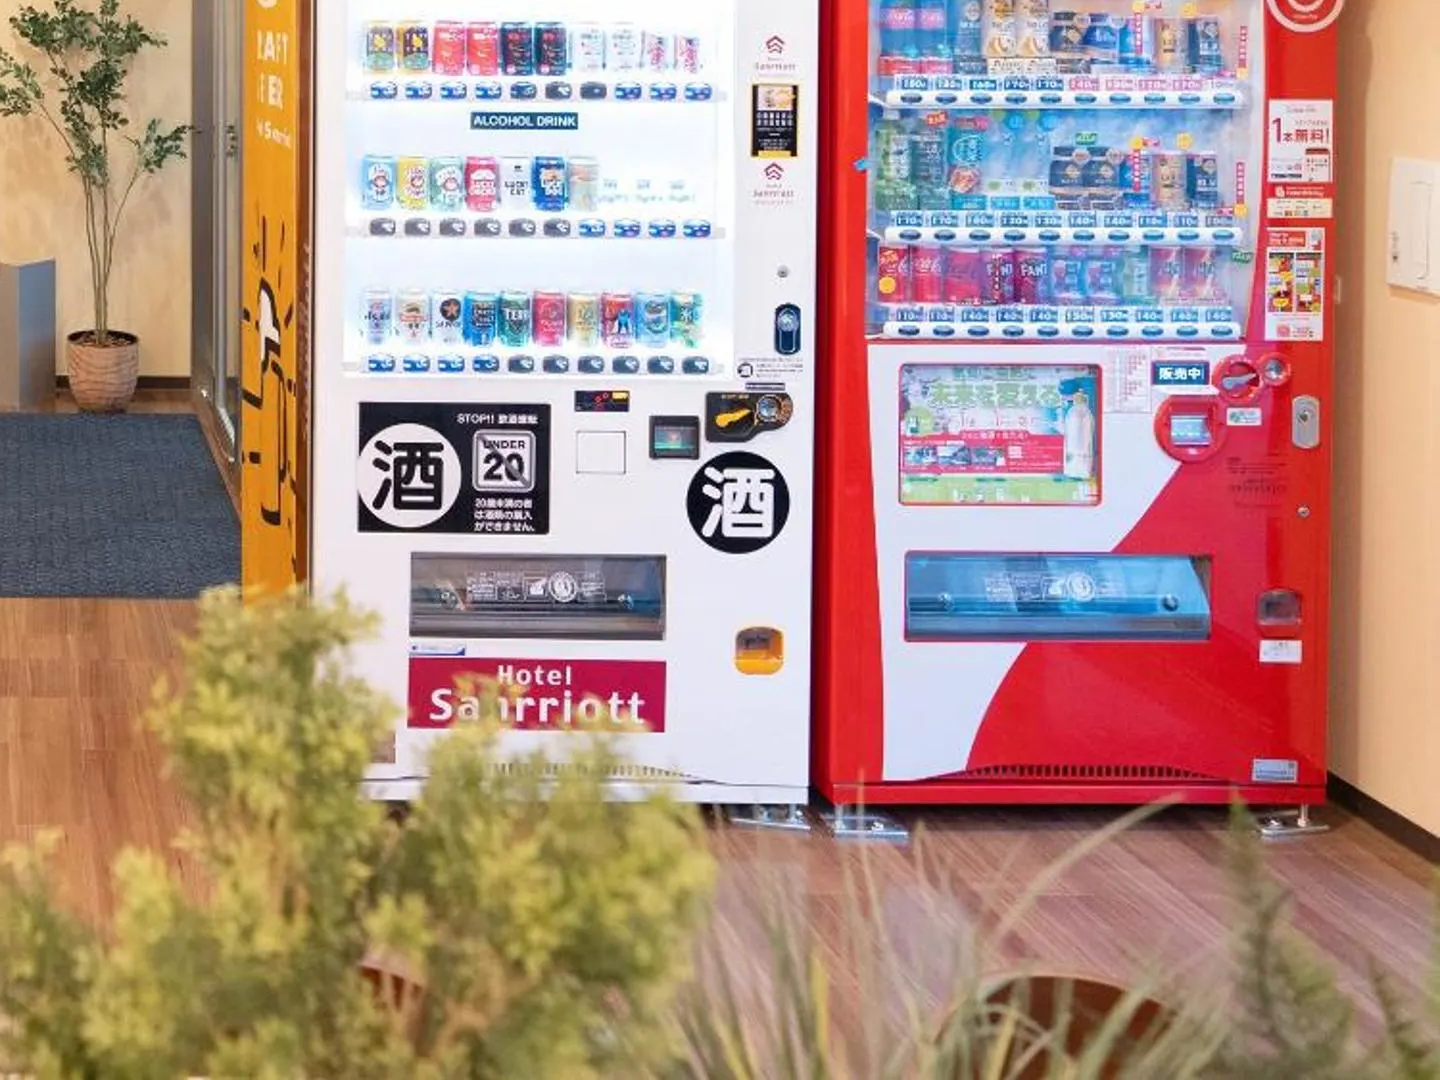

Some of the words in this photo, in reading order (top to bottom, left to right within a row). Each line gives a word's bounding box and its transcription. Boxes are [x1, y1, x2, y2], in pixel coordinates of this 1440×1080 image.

[472, 115, 534, 127] ALCOHOL
[536, 115, 577, 128] DRINK
[1159, 366, 1202, 380] 販売中
[483, 439, 527, 450] UNDER
[371, 440, 445, 511] 酒
[483, 453, 525, 482] 20
[701, 467, 776, 538] 酒
[496, 665, 572, 686] Hotel
